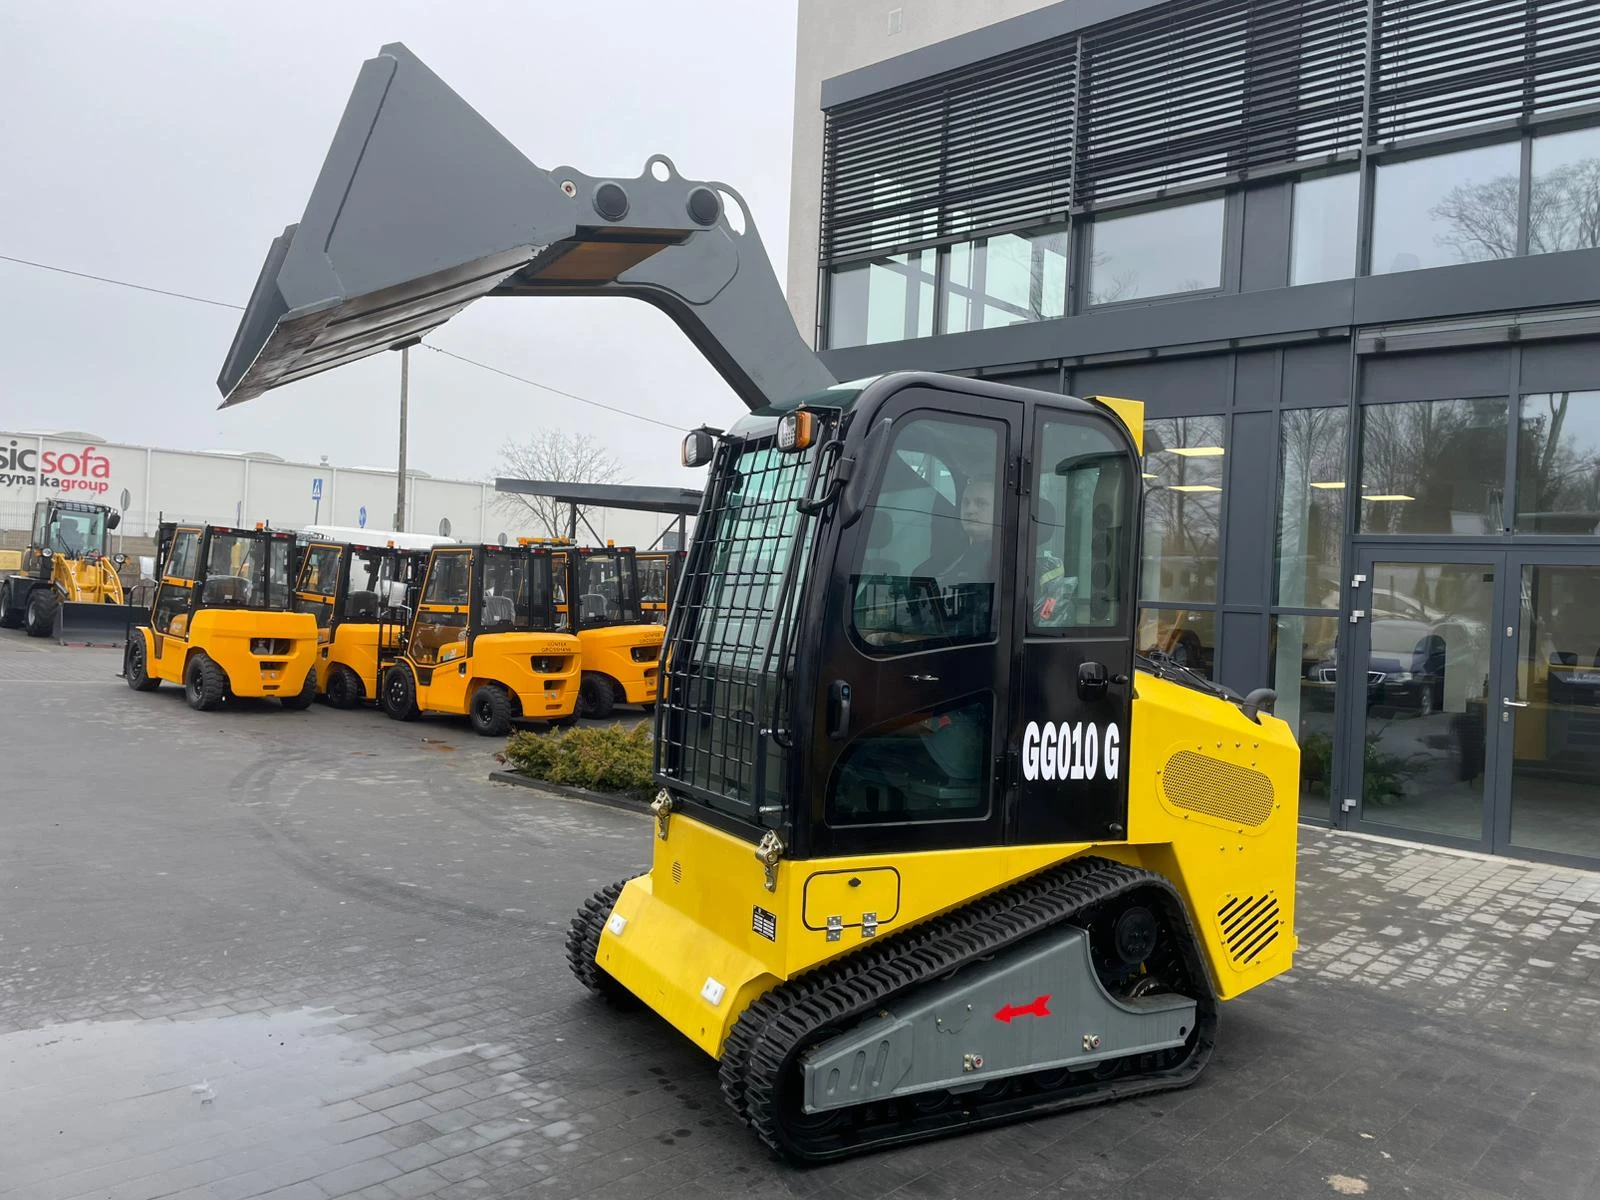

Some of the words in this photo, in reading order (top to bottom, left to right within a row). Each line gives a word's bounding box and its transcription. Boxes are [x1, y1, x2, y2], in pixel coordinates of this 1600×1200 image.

[41, 446, 110, 478] sofa
[1022, 721, 1099, 781] GG010
[1104, 722, 1120, 781] G
